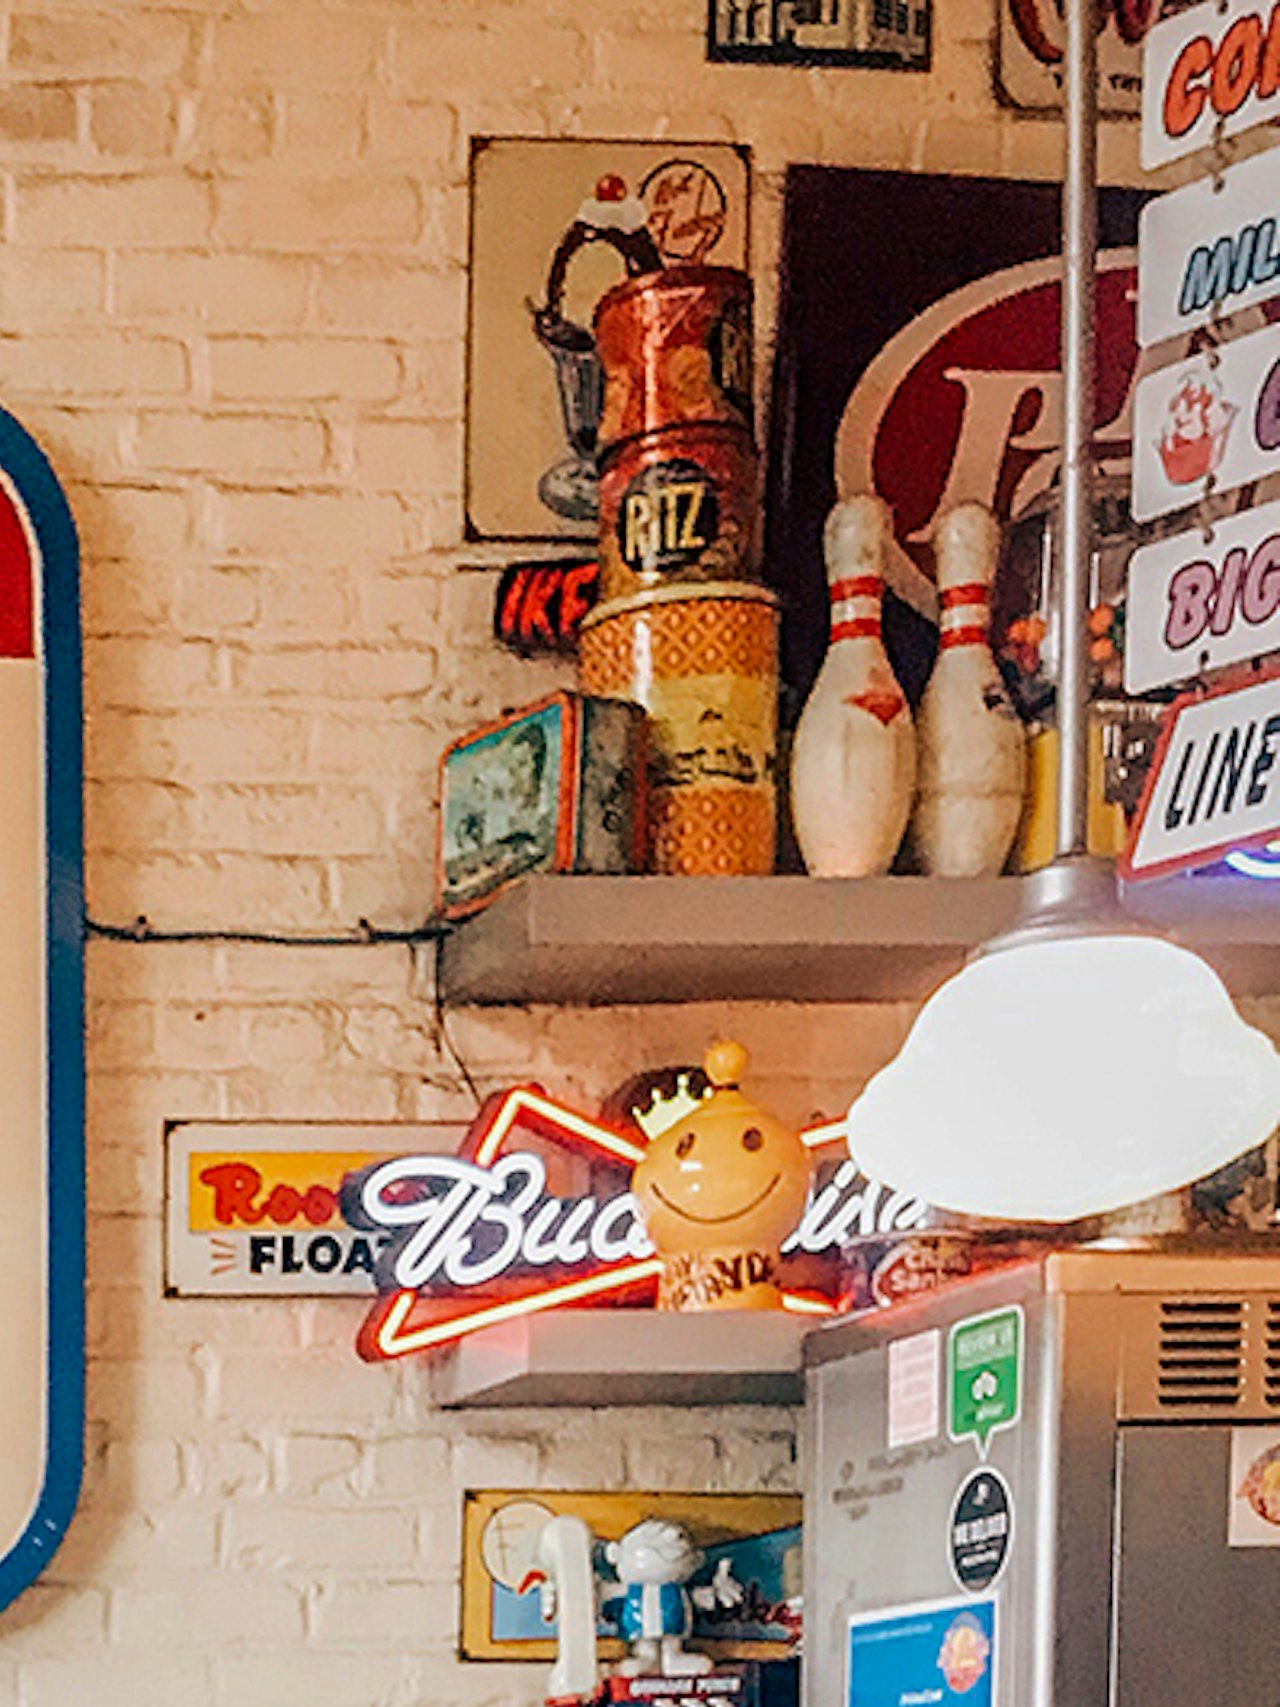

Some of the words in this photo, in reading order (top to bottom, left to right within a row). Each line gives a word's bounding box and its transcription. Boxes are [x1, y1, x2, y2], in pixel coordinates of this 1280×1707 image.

[624, 480, 707, 562] RITZ
[199, 1162, 355, 1225] Roo
[250, 1236, 390, 1274] FLOA
